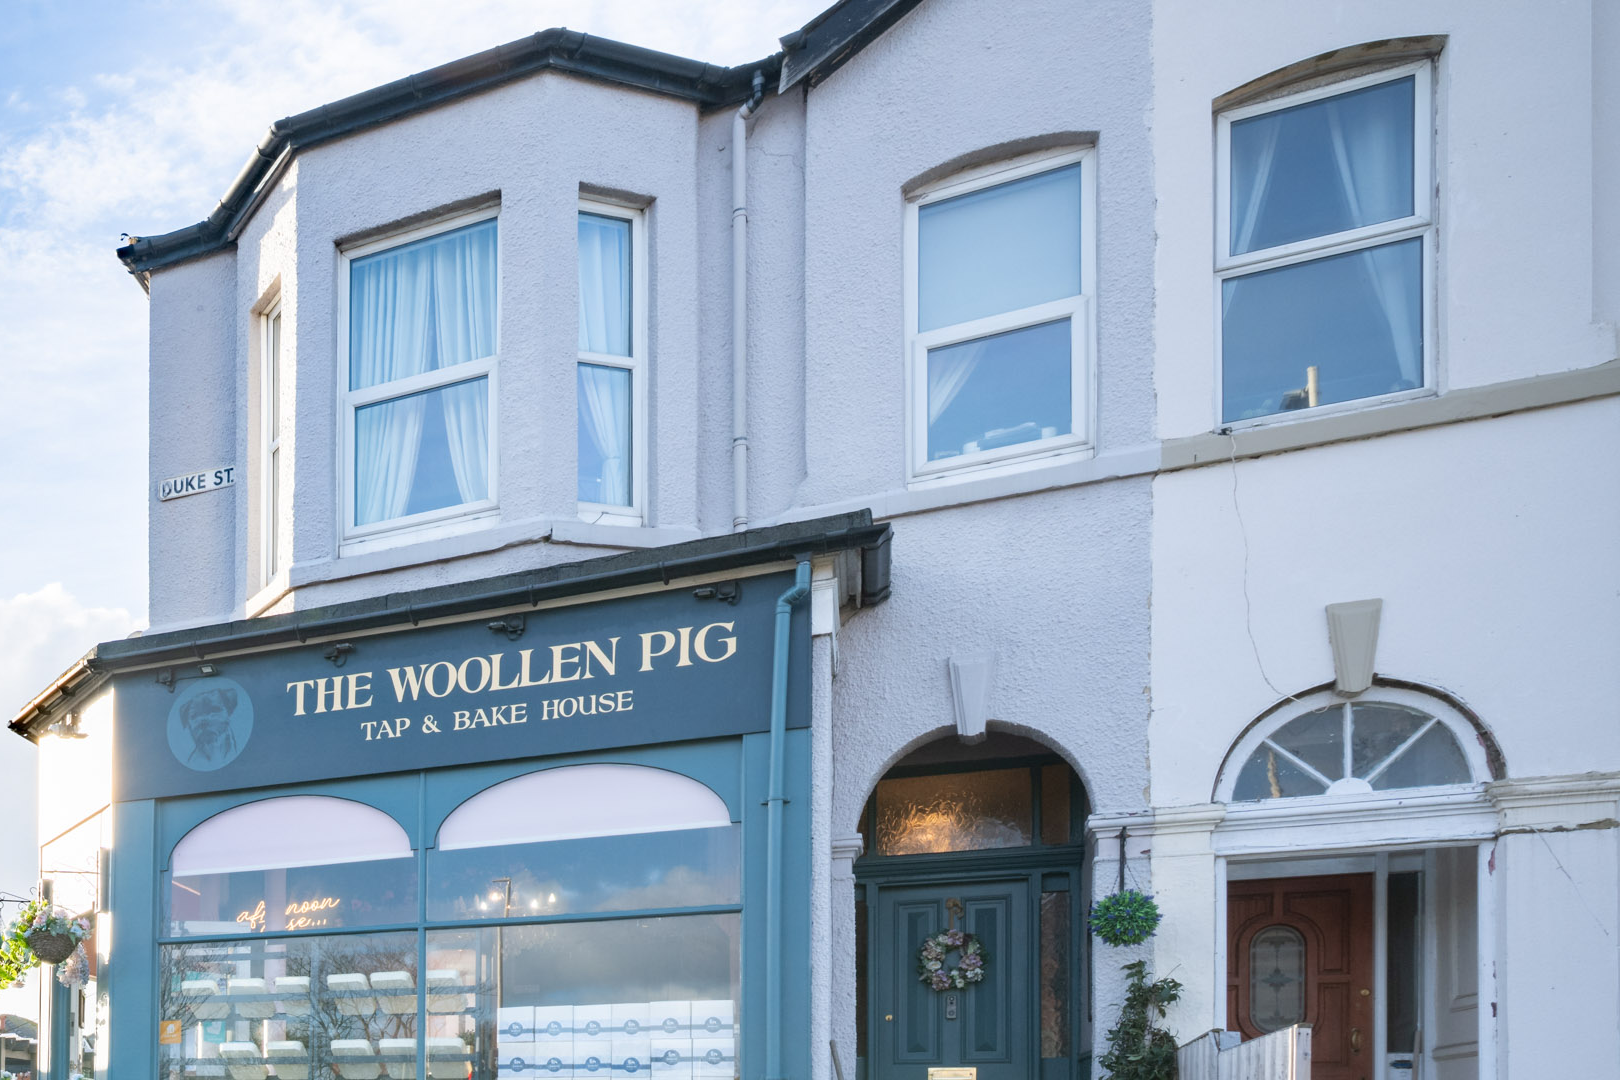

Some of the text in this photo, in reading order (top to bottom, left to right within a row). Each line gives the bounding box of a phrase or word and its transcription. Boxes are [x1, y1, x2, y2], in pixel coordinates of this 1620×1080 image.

[162, 467, 234, 498] DUKE ST.
[286, 620, 738, 716] THE WOOLLEN PIG
[360, 689, 634, 741] TAP & BAKE HOUSE
